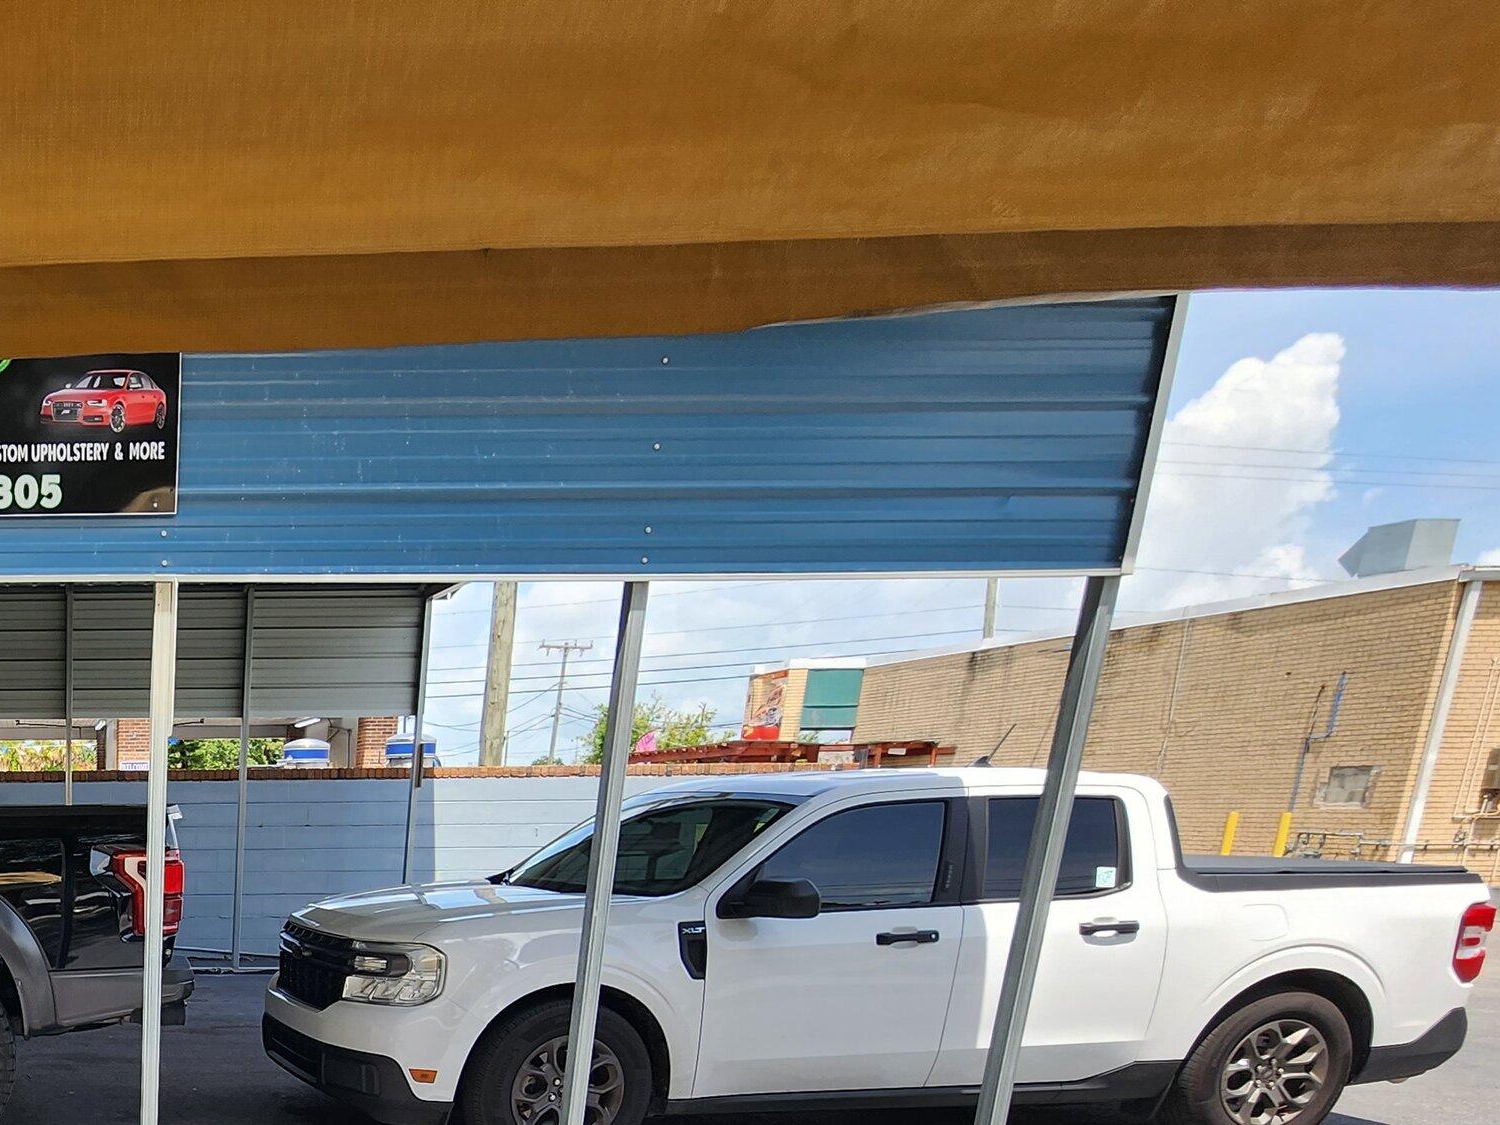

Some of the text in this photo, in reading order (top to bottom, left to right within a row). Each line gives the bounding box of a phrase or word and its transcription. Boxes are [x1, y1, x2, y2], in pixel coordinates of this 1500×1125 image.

[31, 442, 110, 463] UPHOLSTERY
[114, 442, 124, 462] &
[129, 441, 165, 461] MORE
[682, 926, 706, 934] XLT
